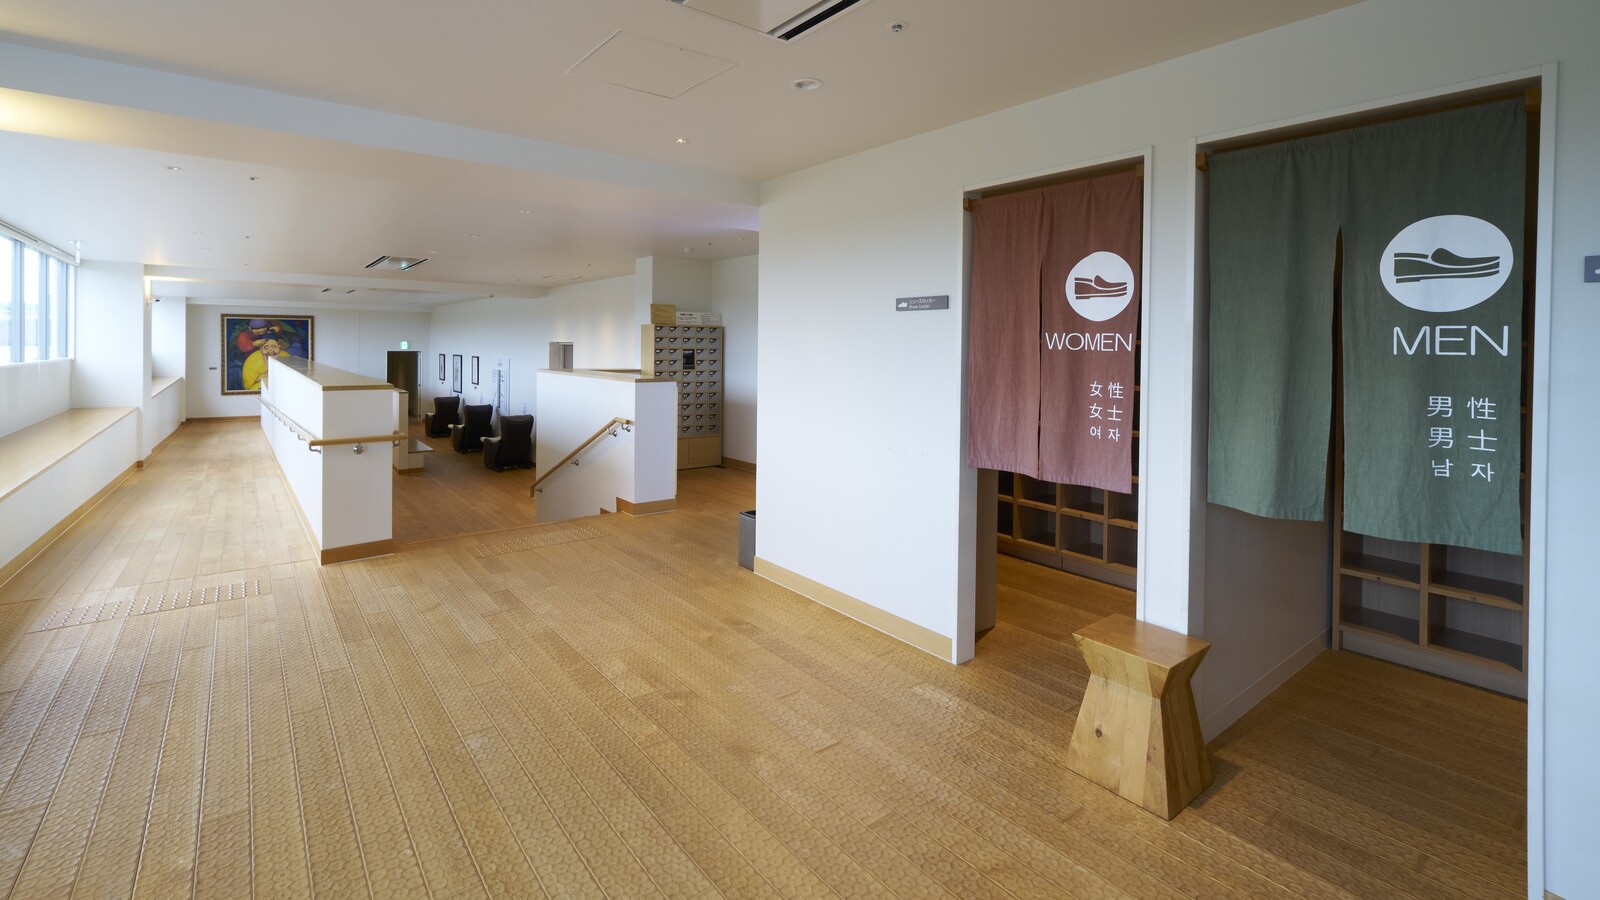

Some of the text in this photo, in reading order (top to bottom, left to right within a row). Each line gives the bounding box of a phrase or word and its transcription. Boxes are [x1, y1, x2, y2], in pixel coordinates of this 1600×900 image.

[1045, 332, 1134, 352] WOMEN
[1393, 325, 1510, 357] MEN
[1089, 380, 1125, 399] 女性
[1088, 402, 1124, 422] 女士
[1427, 395, 1498, 421] 男性
[1428, 427, 1499, 453] 男士
